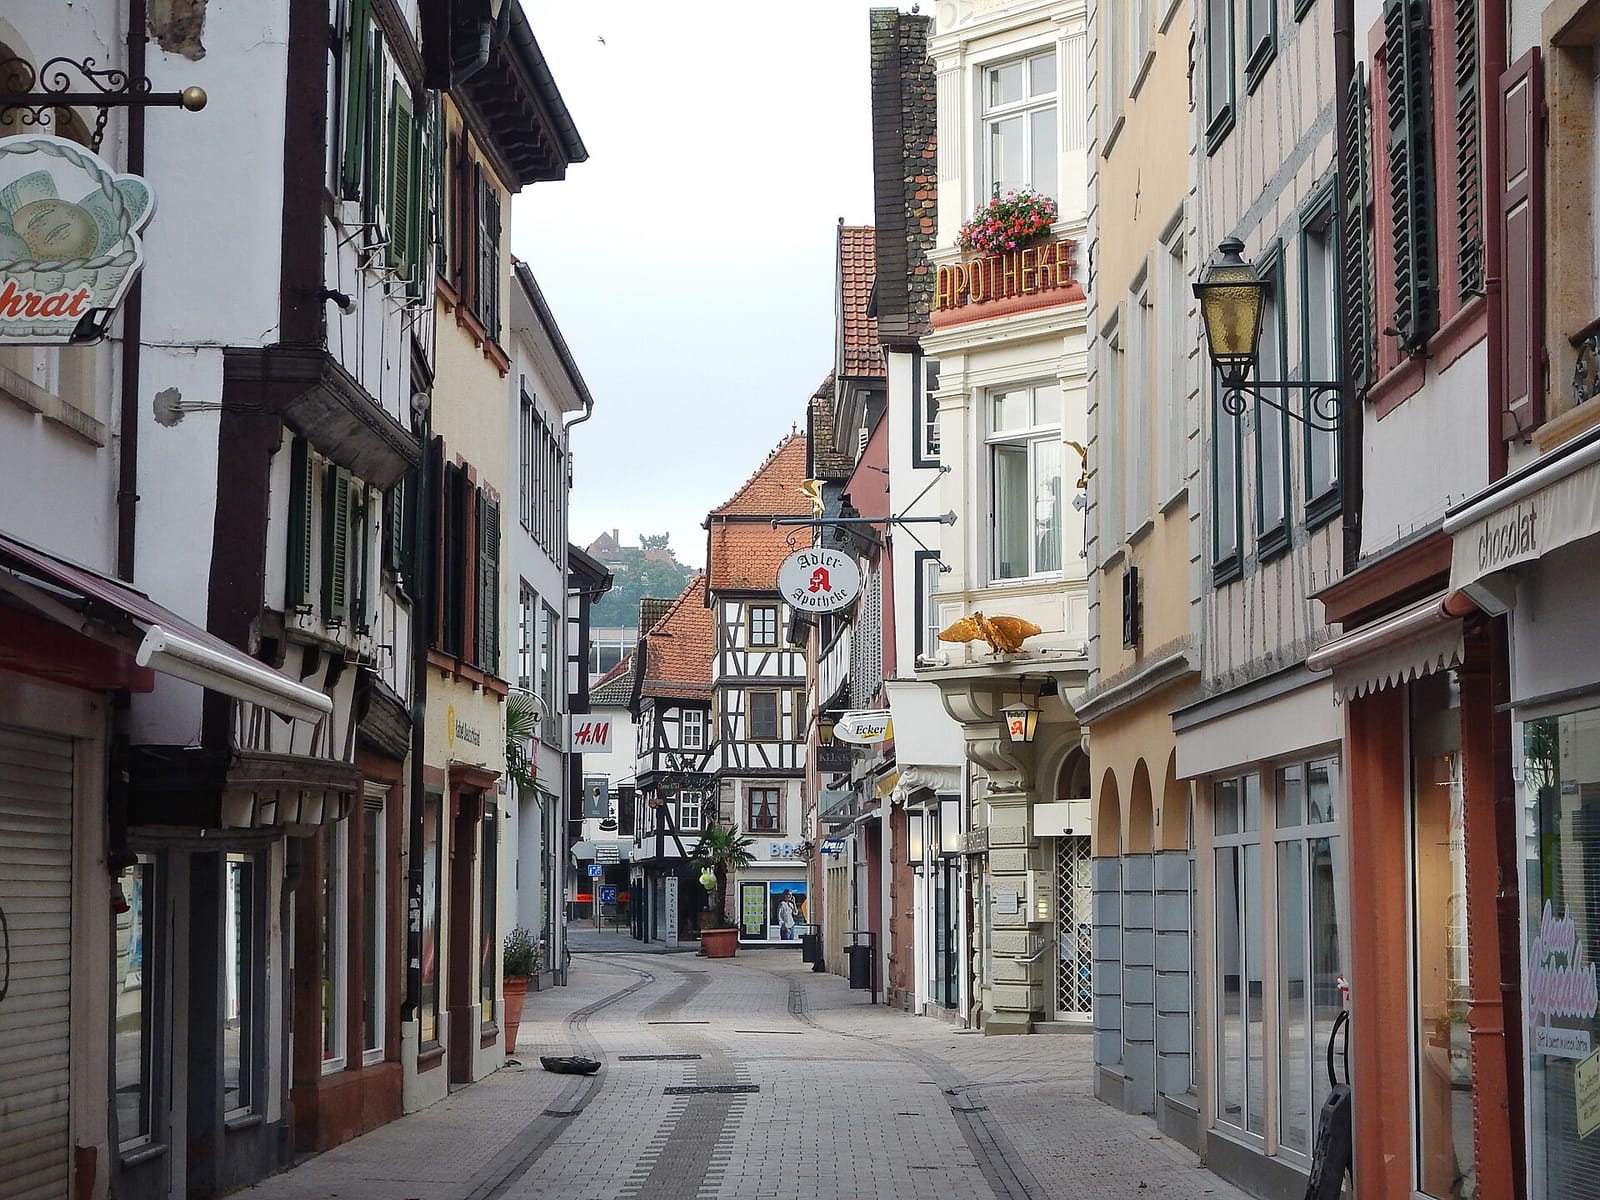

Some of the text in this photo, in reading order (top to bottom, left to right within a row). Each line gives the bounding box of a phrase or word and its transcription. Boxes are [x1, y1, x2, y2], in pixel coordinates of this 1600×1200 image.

[935, 241, 1073, 310] APOTHEKE
[1478, 502, 1538, 571] chocolat
[797, 552, 842, 570] Adler-
[791, 588, 847, 607] Apotheke
[575, 722, 609, 745] H&M
[856, 724, 885, 735] Ecker
